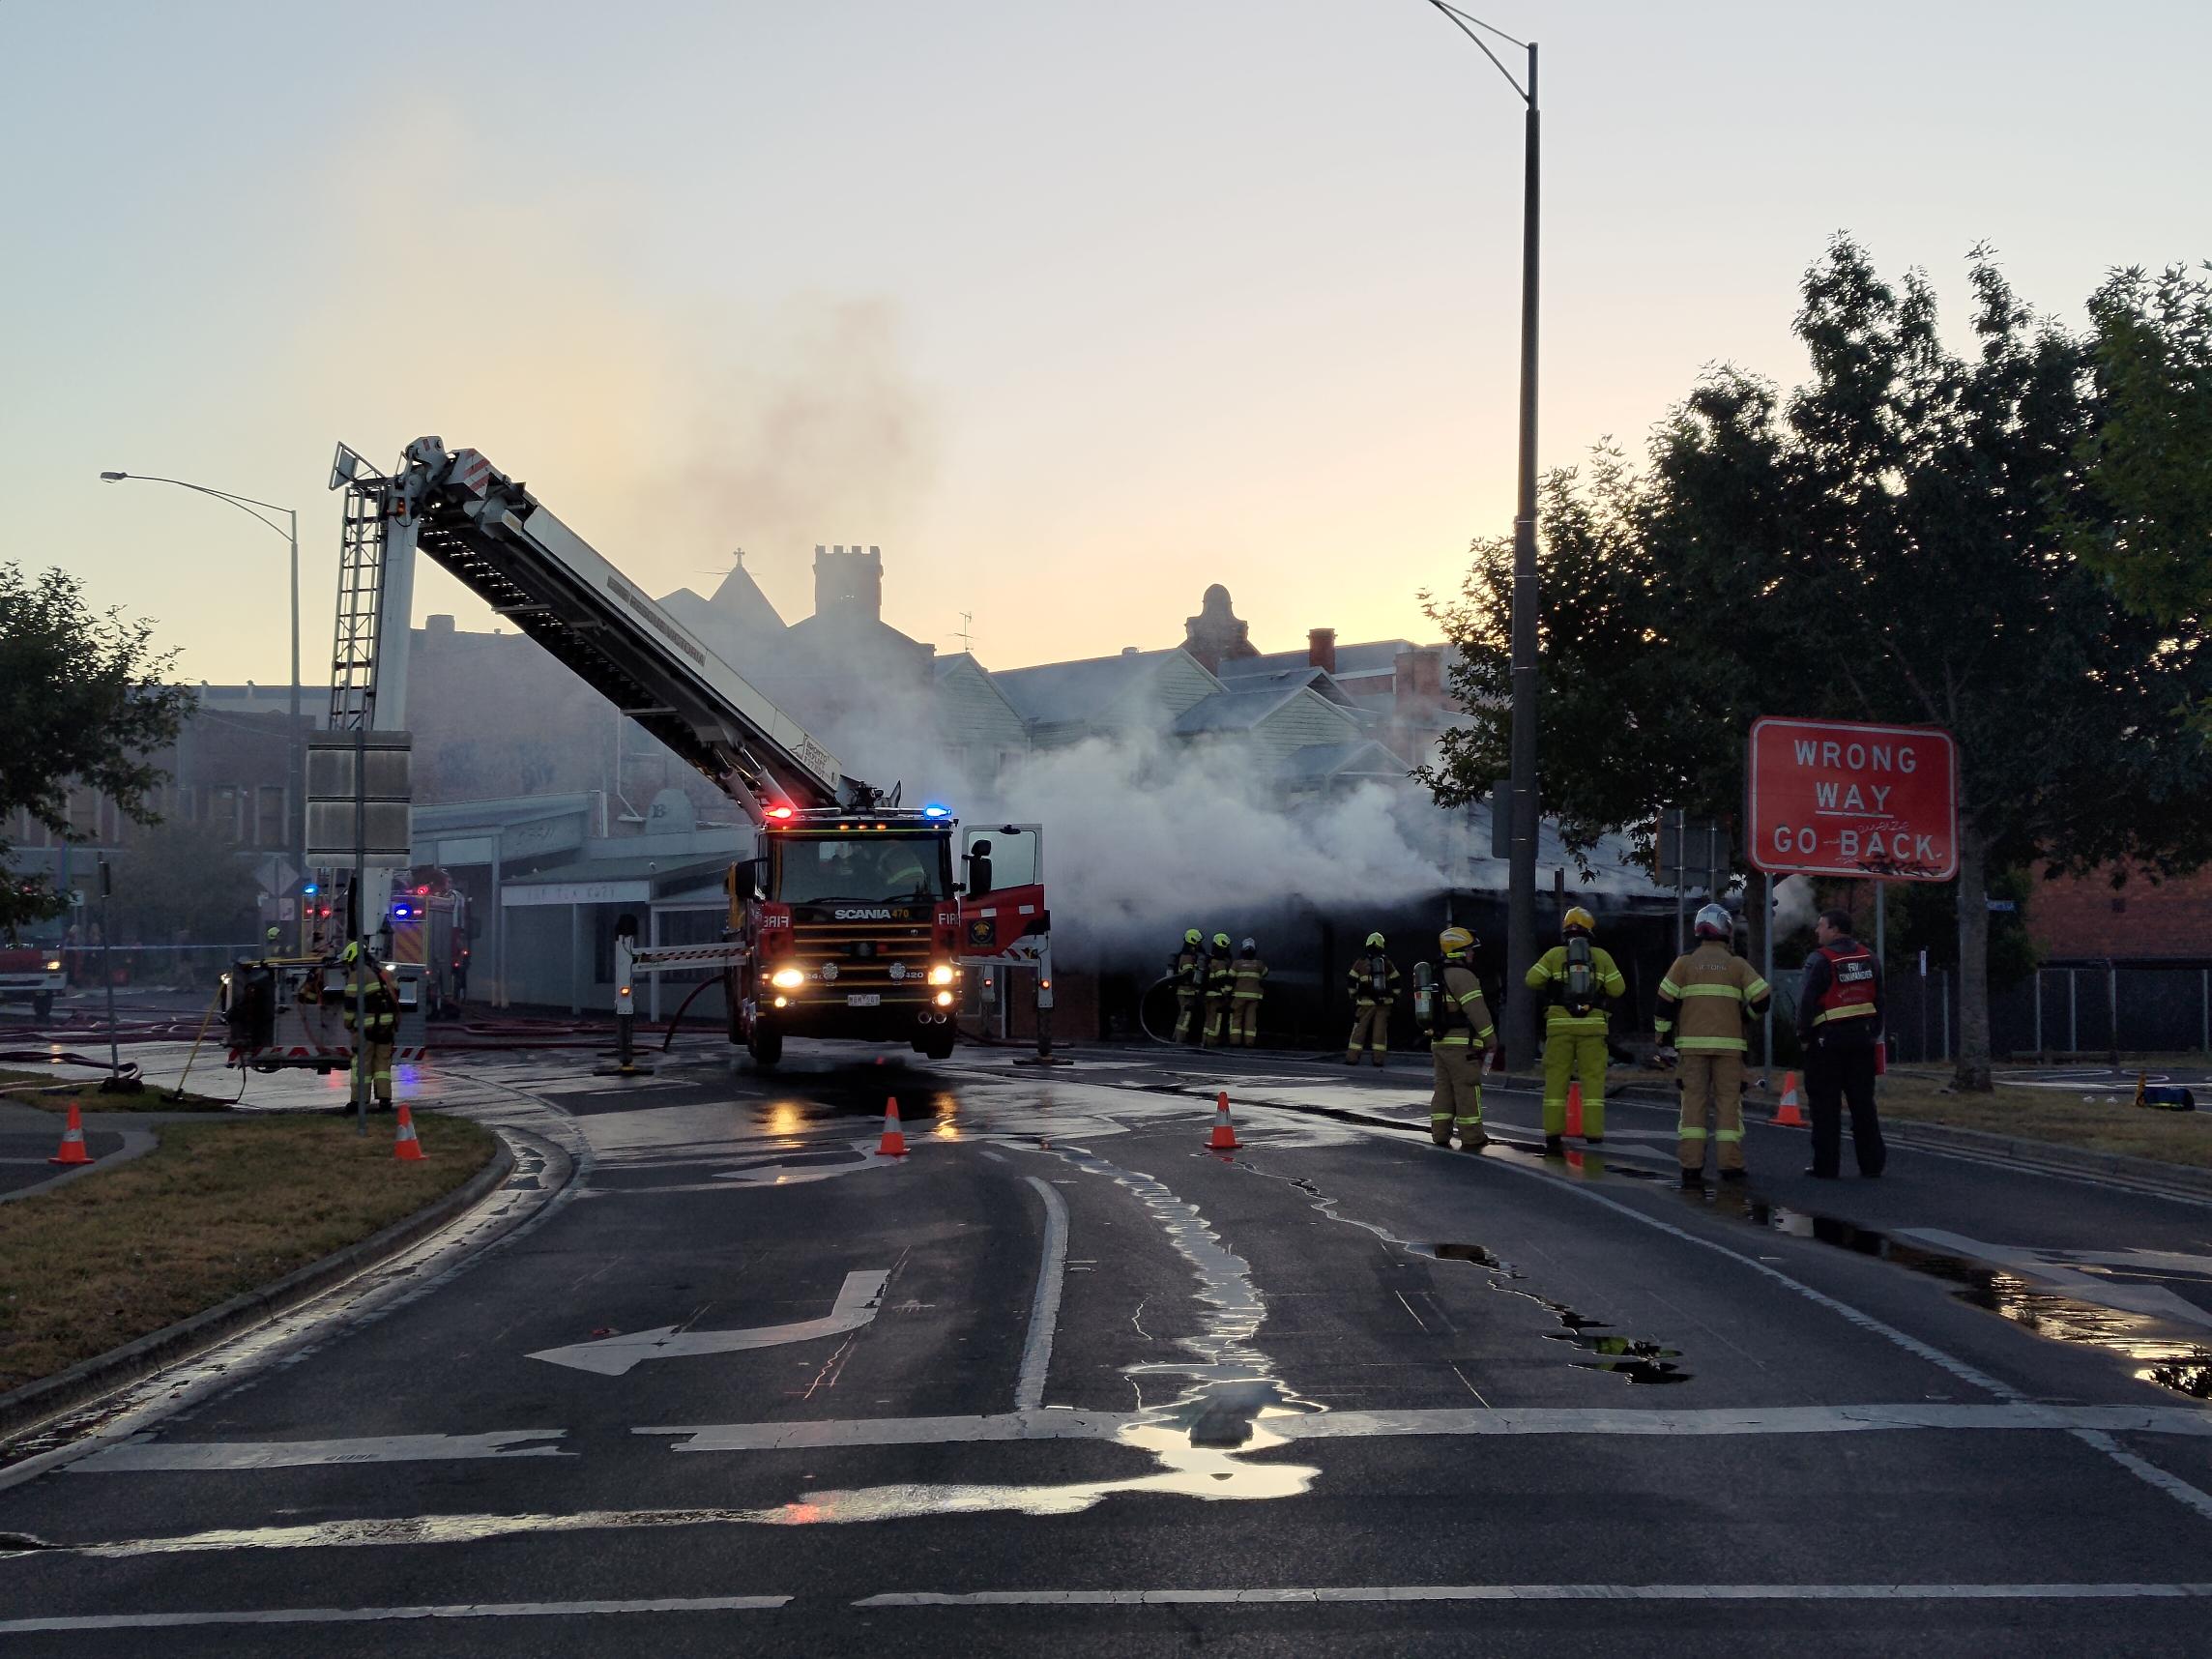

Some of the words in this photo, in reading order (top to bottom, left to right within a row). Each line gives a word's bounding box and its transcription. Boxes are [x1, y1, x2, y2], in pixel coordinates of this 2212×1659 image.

[1794, 740, 1916, 773] WRONG
[1816, 781, 1891, 812] WAY
[1773, 825, 1818, 855] GO
[1840, 830, 1935, 860] BACK
[834, 909, 891, 919] SCANIA
[891, 909, 910, 918] 470
